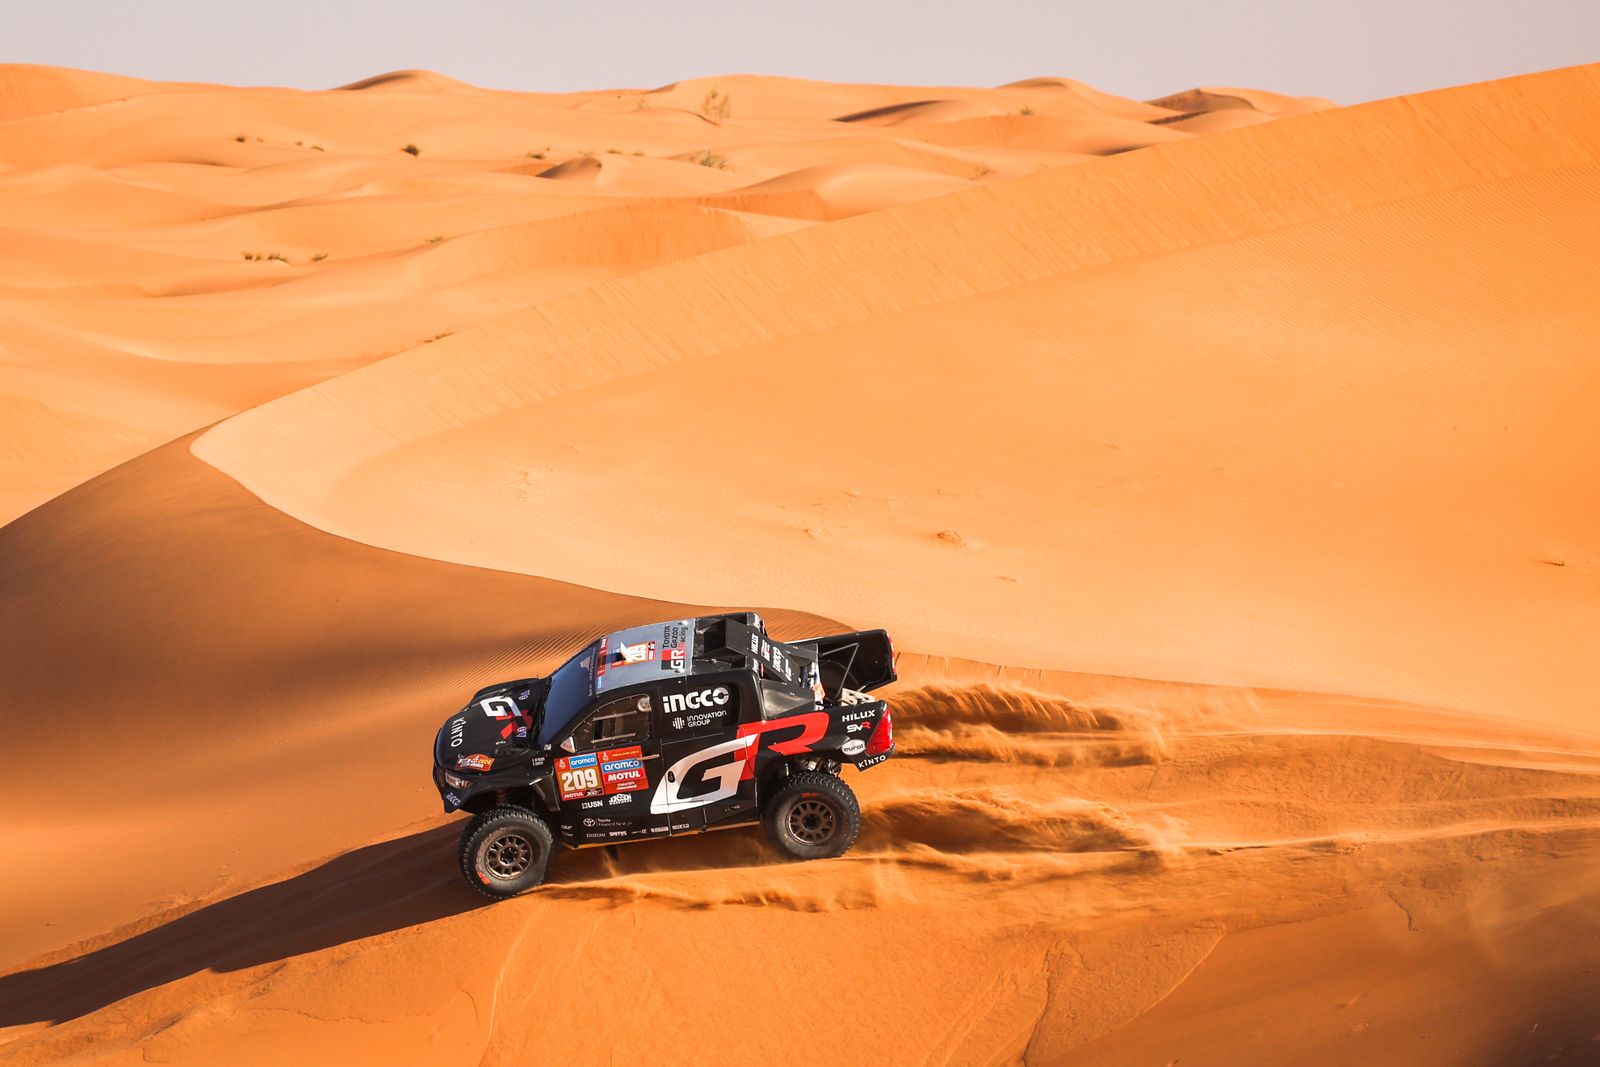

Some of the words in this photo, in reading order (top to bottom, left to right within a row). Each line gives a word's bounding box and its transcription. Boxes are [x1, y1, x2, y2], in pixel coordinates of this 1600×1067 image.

[663, 625, 671, 649] TOYOTA
[671, 627, 679, 648] GAZOO
[671, 649, 686, 671] GR
[687, 719, 711, 728] GROUP
[846, 721, 871, 733] SVR
[843, 744, 864, 754] eurol
[571, 757, 595, 766] aramco
[604, 760, 640, 771] aramco
[561, 768, 598, 792] 209
[608, 770, 641, 782] MOTUL
[564, 791, 584, 799] MOTUL
[588, 800, 603, 809] USN
